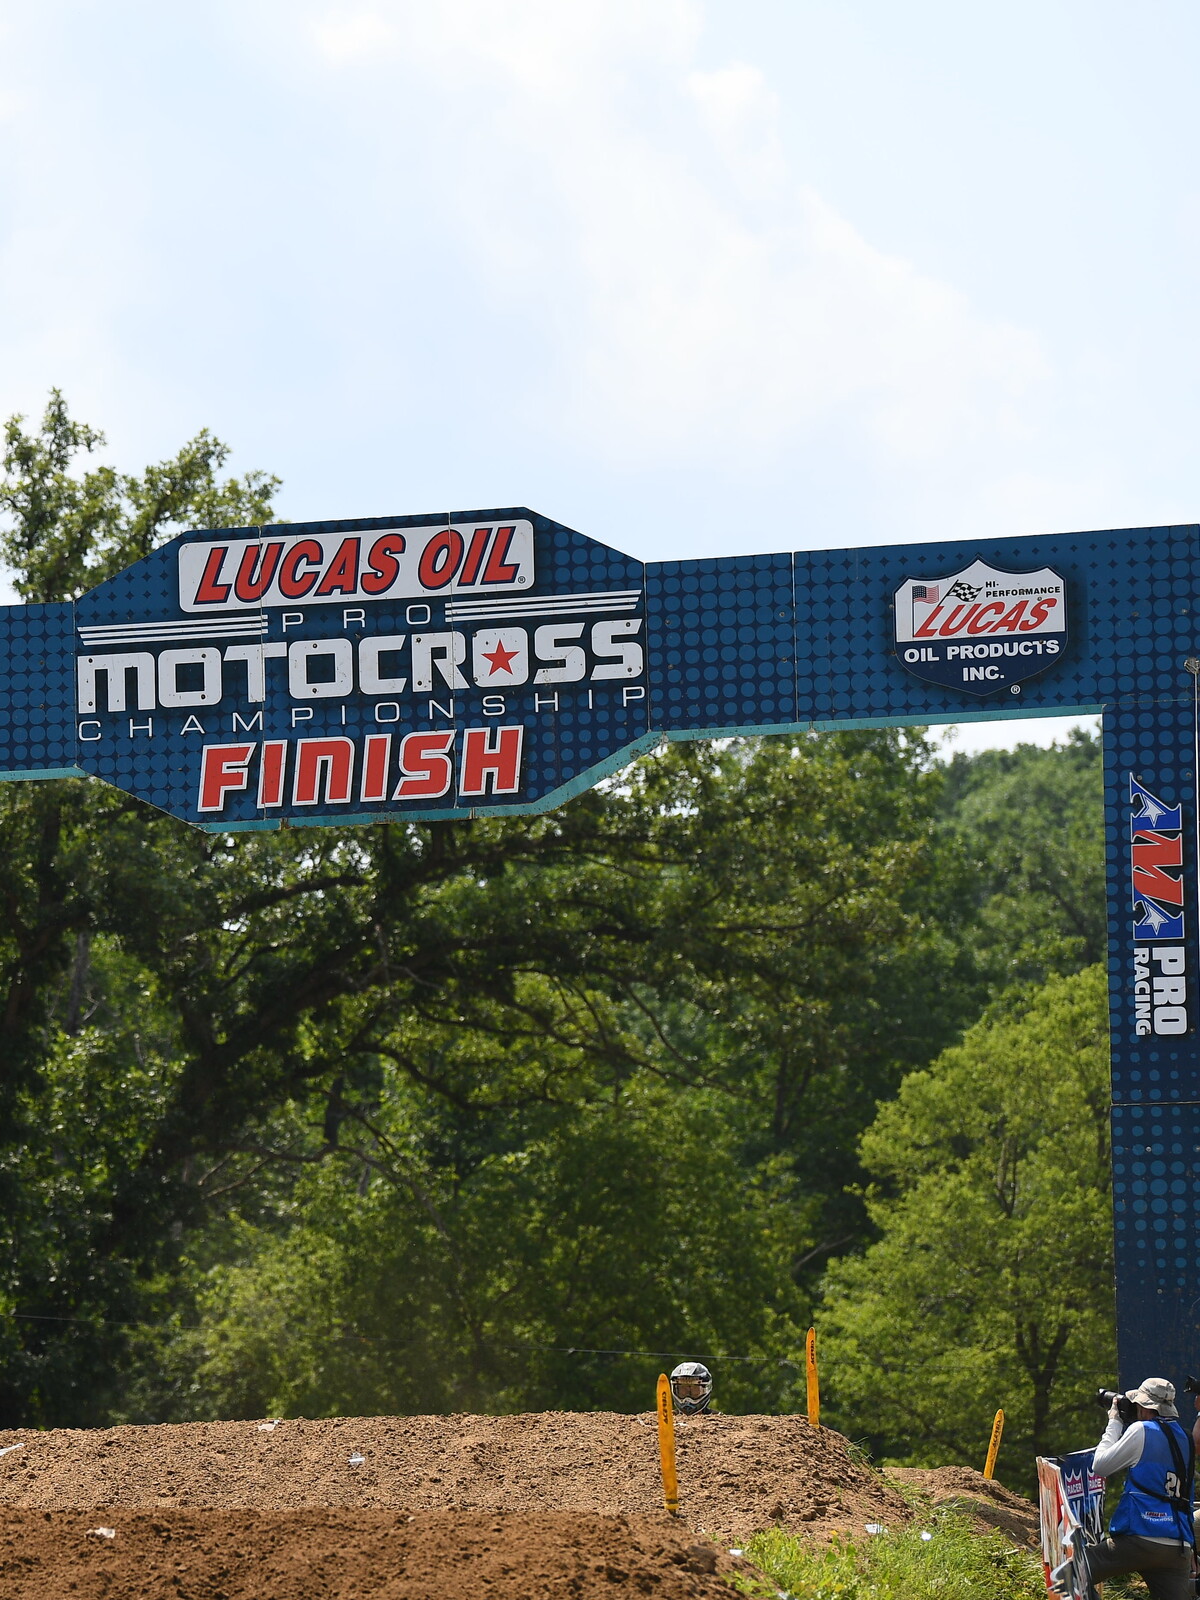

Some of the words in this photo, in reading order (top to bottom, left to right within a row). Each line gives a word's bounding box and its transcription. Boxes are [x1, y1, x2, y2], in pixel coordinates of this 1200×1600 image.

[195, 532, 407, 605] LUCAS
[418, 525, 521, 591] OIL
[985, 586, 1061, 598] PERFORMANCE
[282, 604, 432, 633] PRO
[913, 598, 1058, 638] LUCAS
[77, 618, 644, 714] MOTOCROSS
[904, 648, 940, 663] OIL
[946, 640, 1060, 661] PRODUCTS
[962, 665, 1005, 682] INC.
[78, 686, 646, 742] CHAMPIONSHIP
[197, 725, 525, 813] FINISH
[1133, 947, 1152, 1037] RACING
[1152, 946, 1188, 1036] PRO
[1067, 1483, 1082, 1494] RACER
